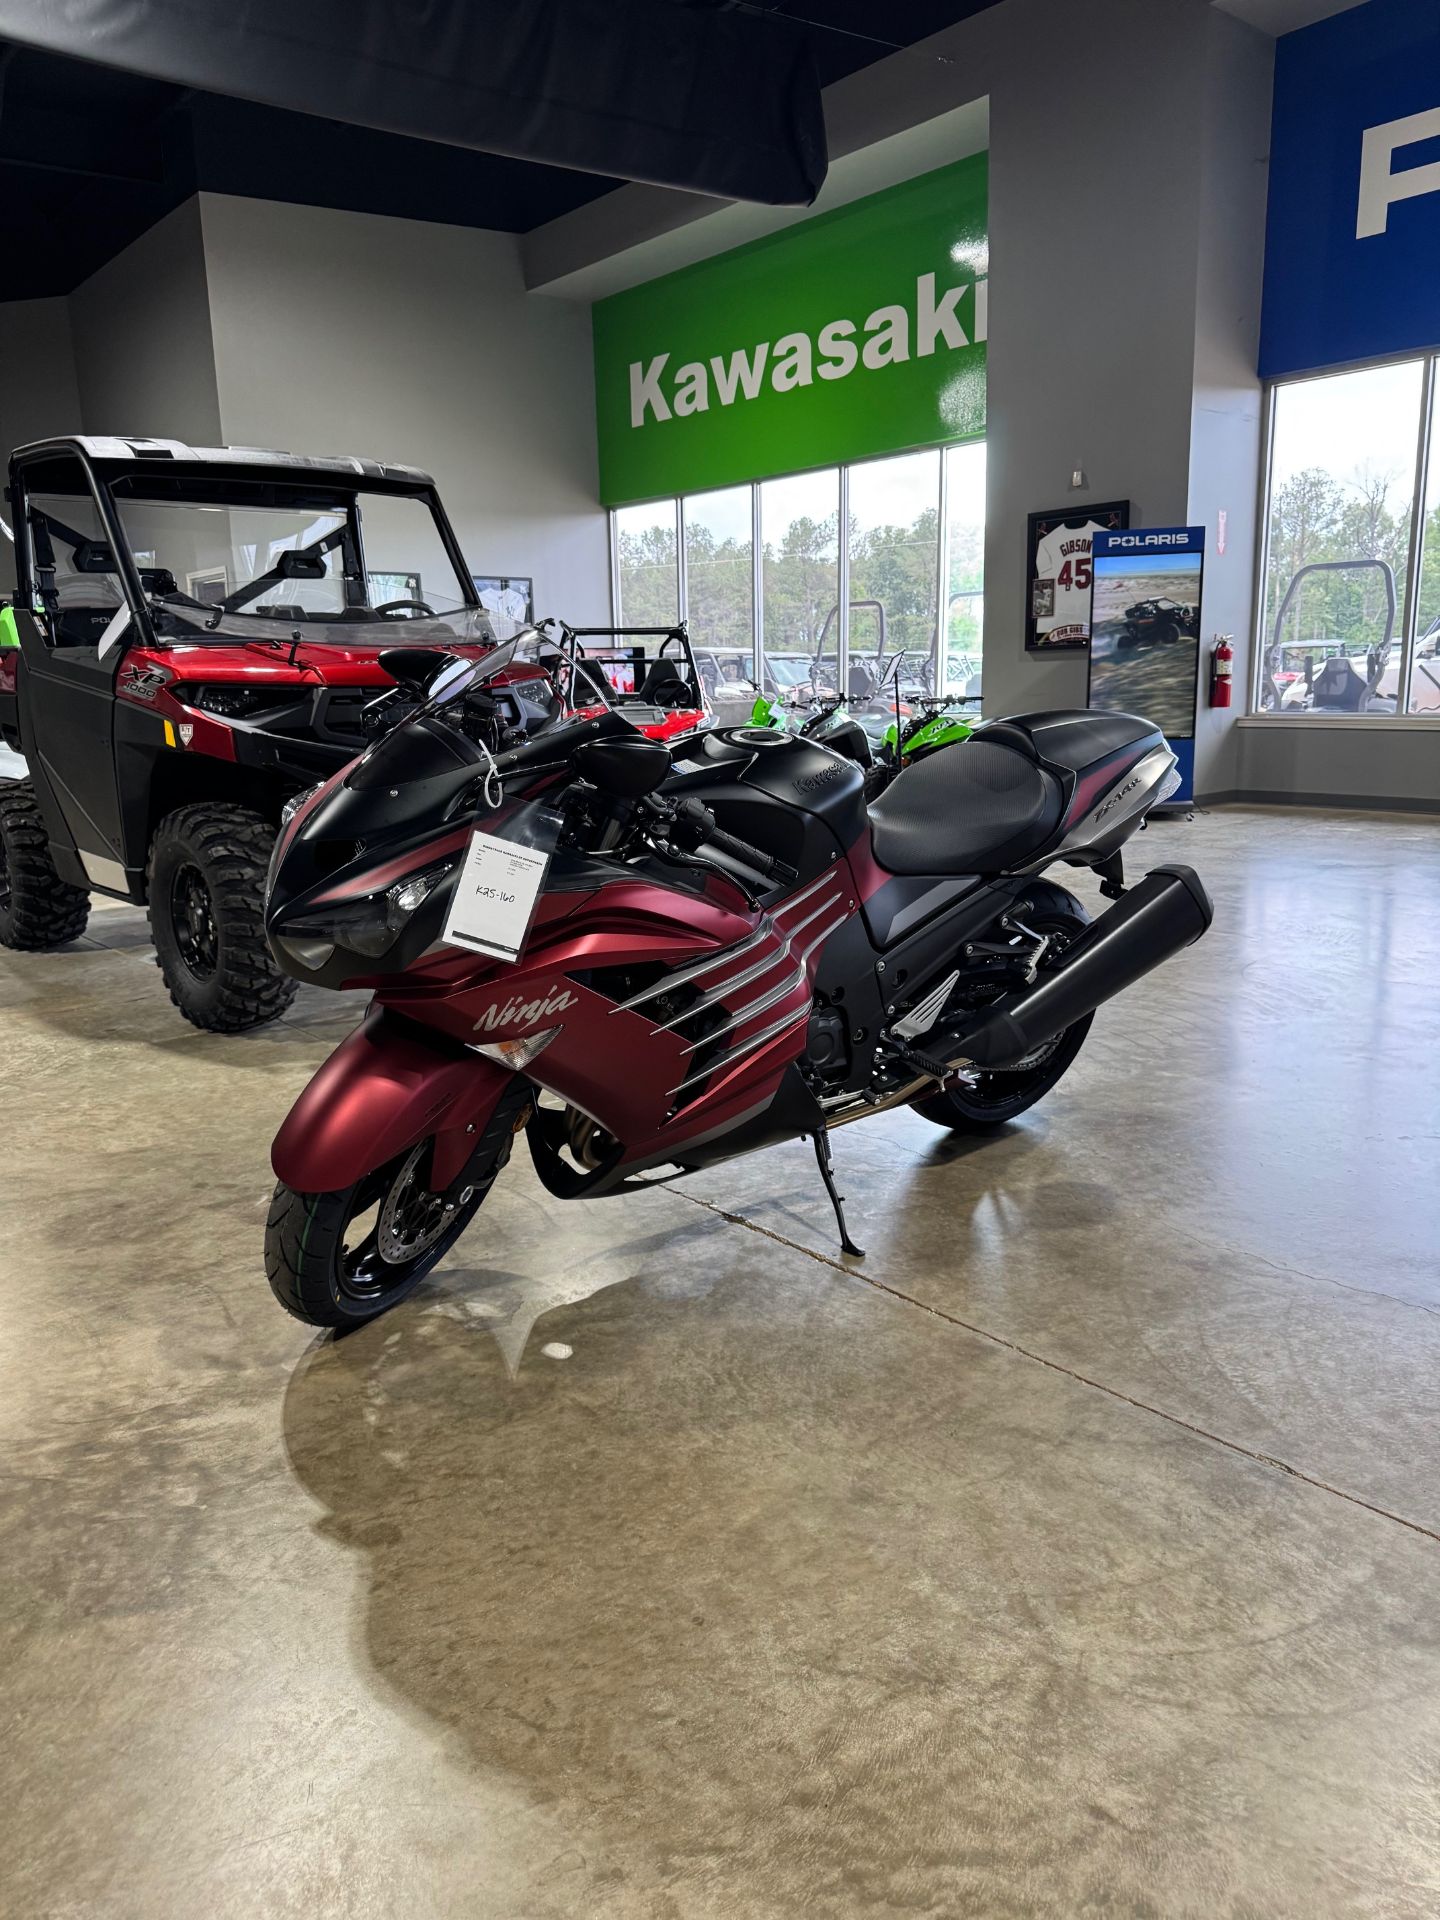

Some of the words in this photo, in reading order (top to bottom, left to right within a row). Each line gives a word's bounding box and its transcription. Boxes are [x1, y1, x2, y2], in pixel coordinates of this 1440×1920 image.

[629, 264, 988, 428] Kawasaki
[1108, 533, 1190, 548] POLARIS
[1057, 558, 1092, 590] 45
[120, 664, 167, 686] XP
[125, 682, 157, 699] 1000
[475, 884, 516, 904] K25-160
[472, 984, 579, 1033] Ninja
